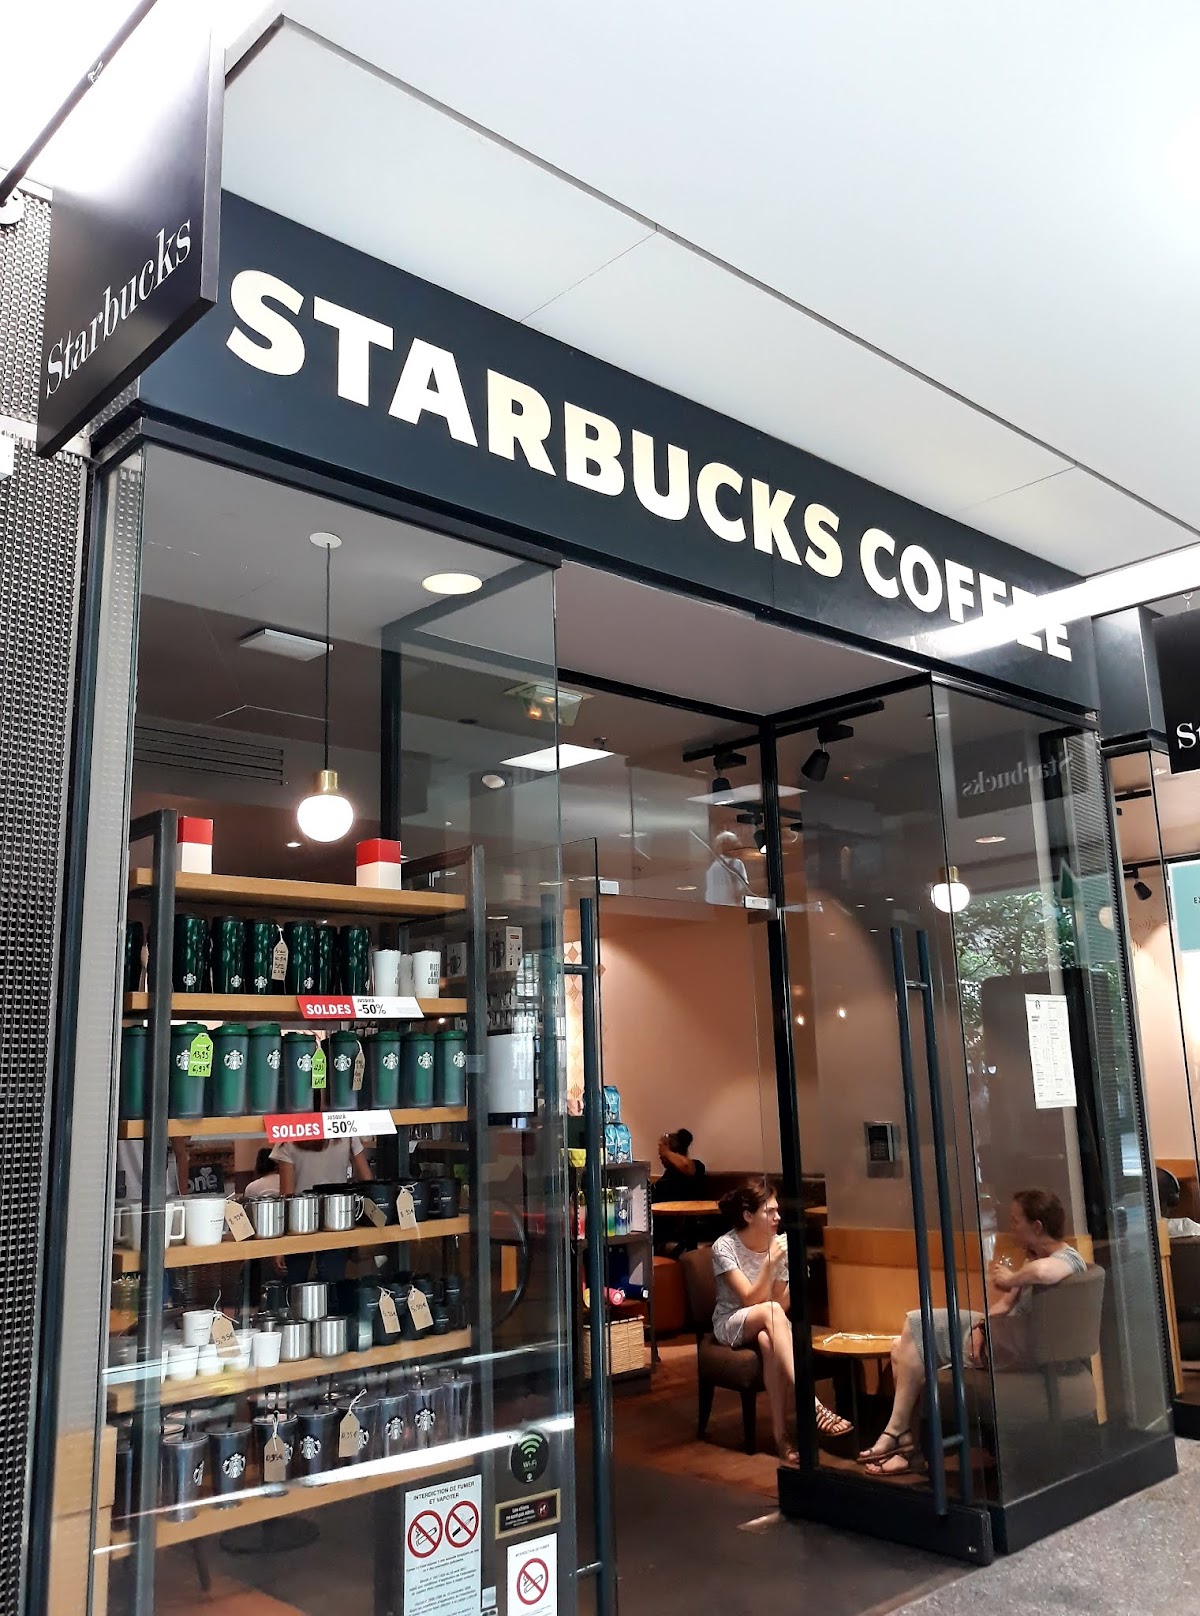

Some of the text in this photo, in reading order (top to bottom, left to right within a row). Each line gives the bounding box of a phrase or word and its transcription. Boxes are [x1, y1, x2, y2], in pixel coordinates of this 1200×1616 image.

[46, 219, 192, 400] Starbucks
[226, 269, 844, 578] STARBUCKS
[306, 1003, 352, 1015] SOLDES
[358, 1003, 387, 1015] -50%
[271, 1122, 321, 1139] SOLDES
[327, 1120, 358, 1134] -50%
[522, 1459, 538, 1469] Wi-Fi
[413, 1486, 449, 1501] INTERDICTION
[449, 1485, 457, 1493] DE
[436, 1492, 460, 1503] VAPOTER
